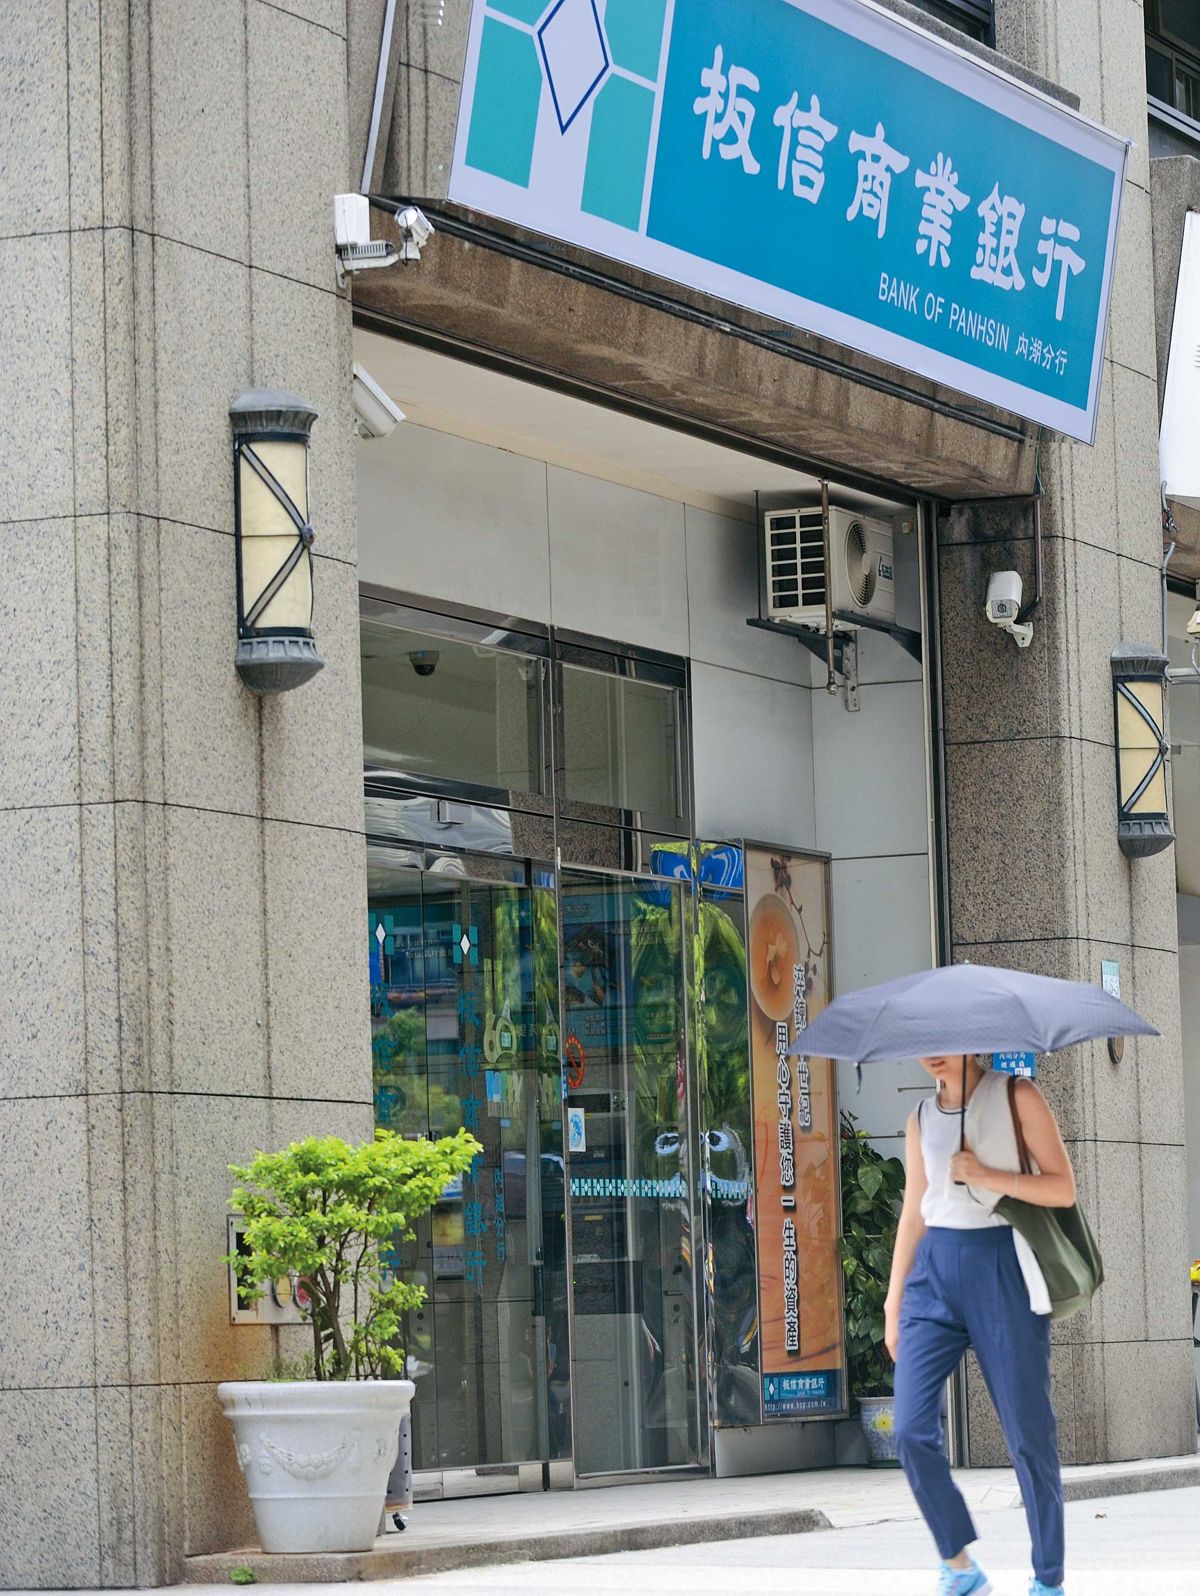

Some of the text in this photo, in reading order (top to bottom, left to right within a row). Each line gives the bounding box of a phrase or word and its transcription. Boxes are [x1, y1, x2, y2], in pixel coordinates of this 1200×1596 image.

[693, 44, 1086, 321] 板信商業銀行
[878, 272, 1010, 352] BANK OF PANHSIN
[1016, 333, 1067, 376] 內湖分行
